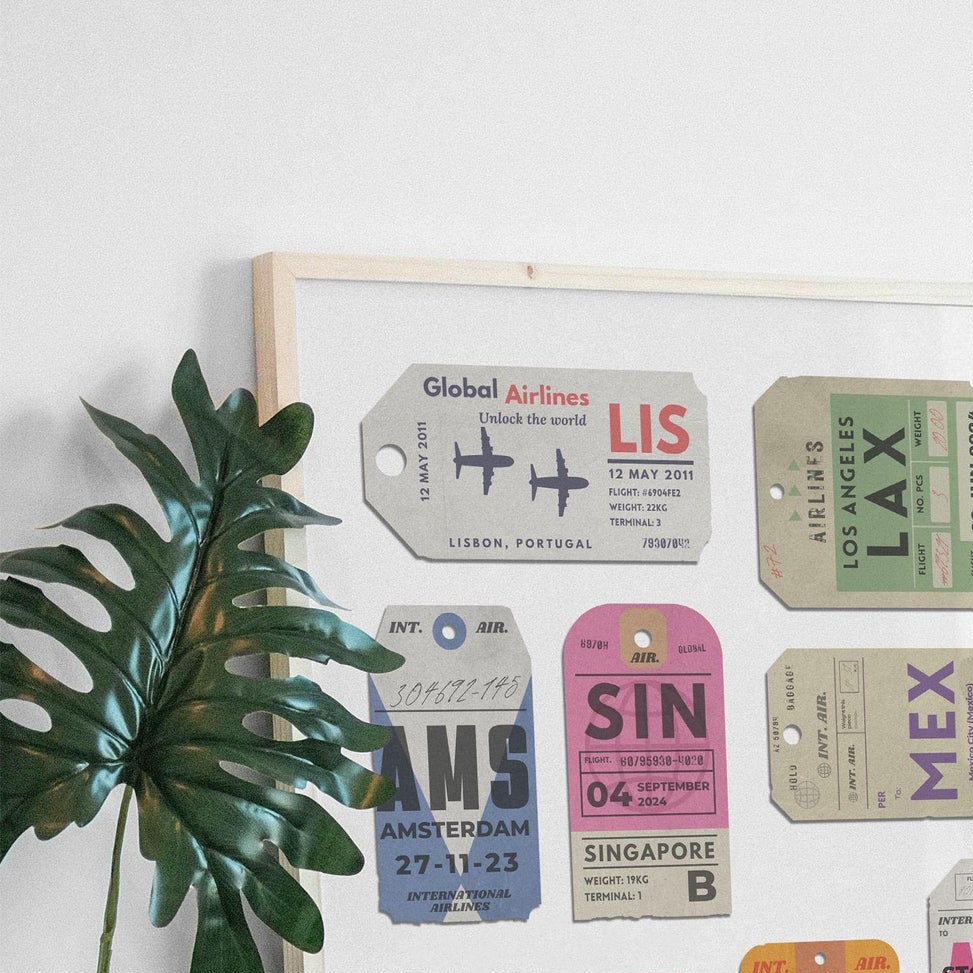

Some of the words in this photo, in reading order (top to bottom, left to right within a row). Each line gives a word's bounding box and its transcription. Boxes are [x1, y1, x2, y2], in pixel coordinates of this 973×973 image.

[424, 377, 498, 399] Global
[505, 385, 589, 407] Airlines
[479, 412, 523, 425] Unlock
[527, 413, 547, 425] the
[550, 414, 586, 426] world
[418, 422, 427, 449] 2011
[608, 403, 691, 455] LIS
[419, 456, 429, 484] MAY
[609, 469, 623, 479] 12
[629, 469, 658, 480] MAY
[665, 470, 693, 481] 2011
[839, 416, 857, 515] ANGELES
[421, 488, 430, 501] 12
[609, 489, 640, 497] FLIGHT:
[863, 428, 909, 556] LAX
[609, 504, 644, 512] WEIGHT:
[647, 504, 667, 512] 22KG
[450, 538, 508, 549] LISBON,
[517, 539, 592, 549] PORTUGAL
[842, 526, 858, 569] LOS
[389, 622, 422, 633] INT.
[475, 622, 508, 633] AIR.
[630, 652, 659, 663] AIR.
[585, 682, 706, 740] SIN
[817, 692, 827, 723] AIR.
[907, 660, 958, 800] MEX
[817, 729, 828, 760] INT.
[377, 724, 529, 811] AMS
[587, 781, 632, 808] 04
[637, 782, 709, 791] SEPTEMBER
[638, 797, 667, 806] 2024
[878, 791, 886, 808] PER
[380, 820, 530, 839] AMSTERDAM
[584, 842, 715, 863] SINGAPORE
[395, 853, 518, 875] 27-11-23
[584, 877, 624, 885] WEIGHT:
[627, 876, 649, 884] 19KG
[688, 870, 716, 902] B
[407, 889, 511, 901] INTERNATIONAL
[585, 893, 635, 902] TERMINAL:
[430, 902, 490, 912] AIRLINES
[855, 956, 890, 970] AIR.
